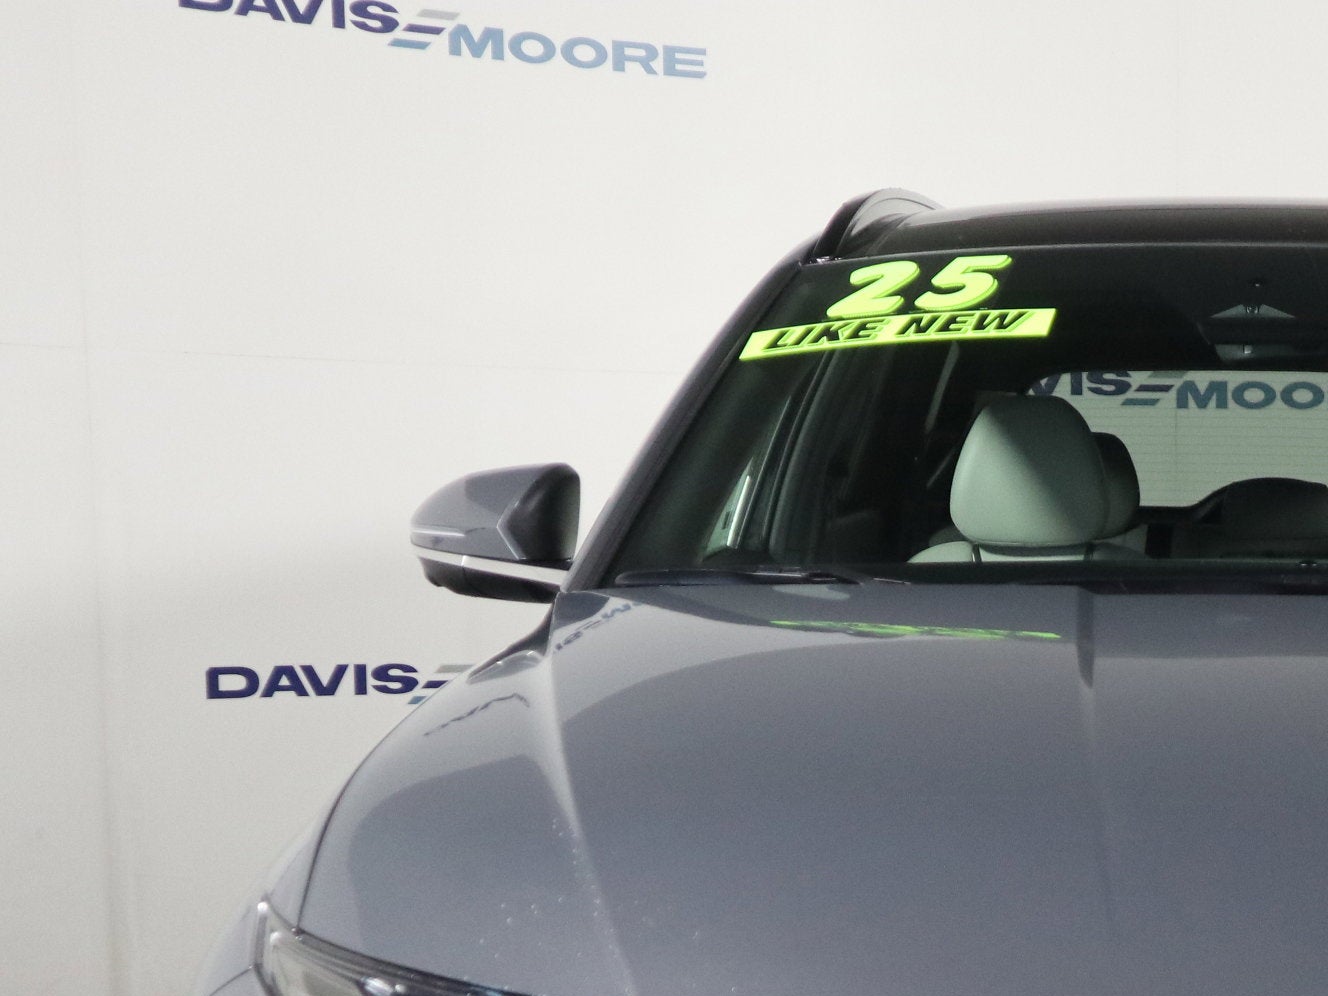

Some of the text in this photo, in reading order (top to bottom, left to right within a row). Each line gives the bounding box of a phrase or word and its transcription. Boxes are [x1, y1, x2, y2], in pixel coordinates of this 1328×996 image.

[448, 26, 707, 79] MOORE
[826, 254, 1013, 319] 25
[761, 310, 1032, 351] LIKE NEW
[1023, 370, 1132, 396] VIS
[206, 663, 419, 699] DAVIS
